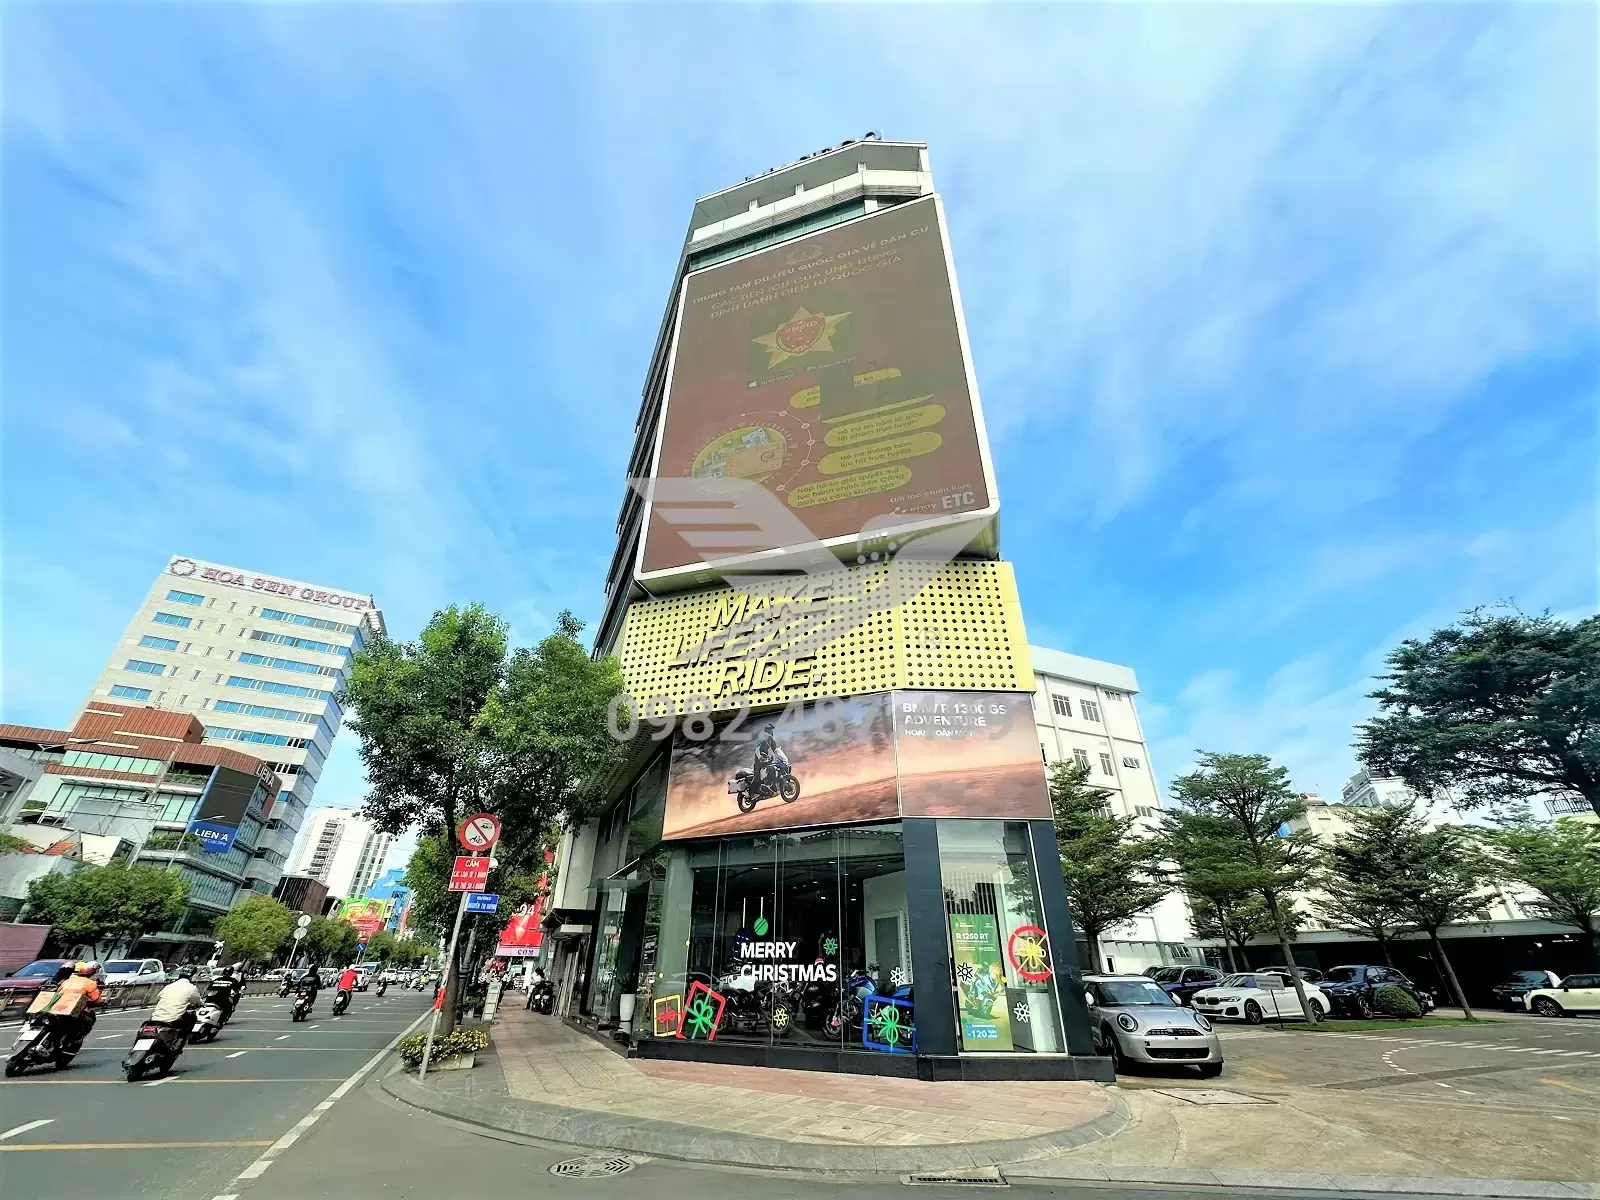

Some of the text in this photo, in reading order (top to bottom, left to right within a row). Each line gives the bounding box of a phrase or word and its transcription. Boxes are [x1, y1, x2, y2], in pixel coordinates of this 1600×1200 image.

[942, 491, 976, 509] ETC
[201, 566, 370, 610] HOA SEN GROUP
[711, 578, 834, 630] MAKE
[668, 618, 791, 668] LIFE A
[713, 653, 823, 697] RIDE.
[902, 703, 1008, 715] BMW R 1300 GS
[904, 715, 987, 726] ADVENTURE
[740, 942, 797, 958] MERRY
[740, 964, 838, 982] CHRISTMAS
